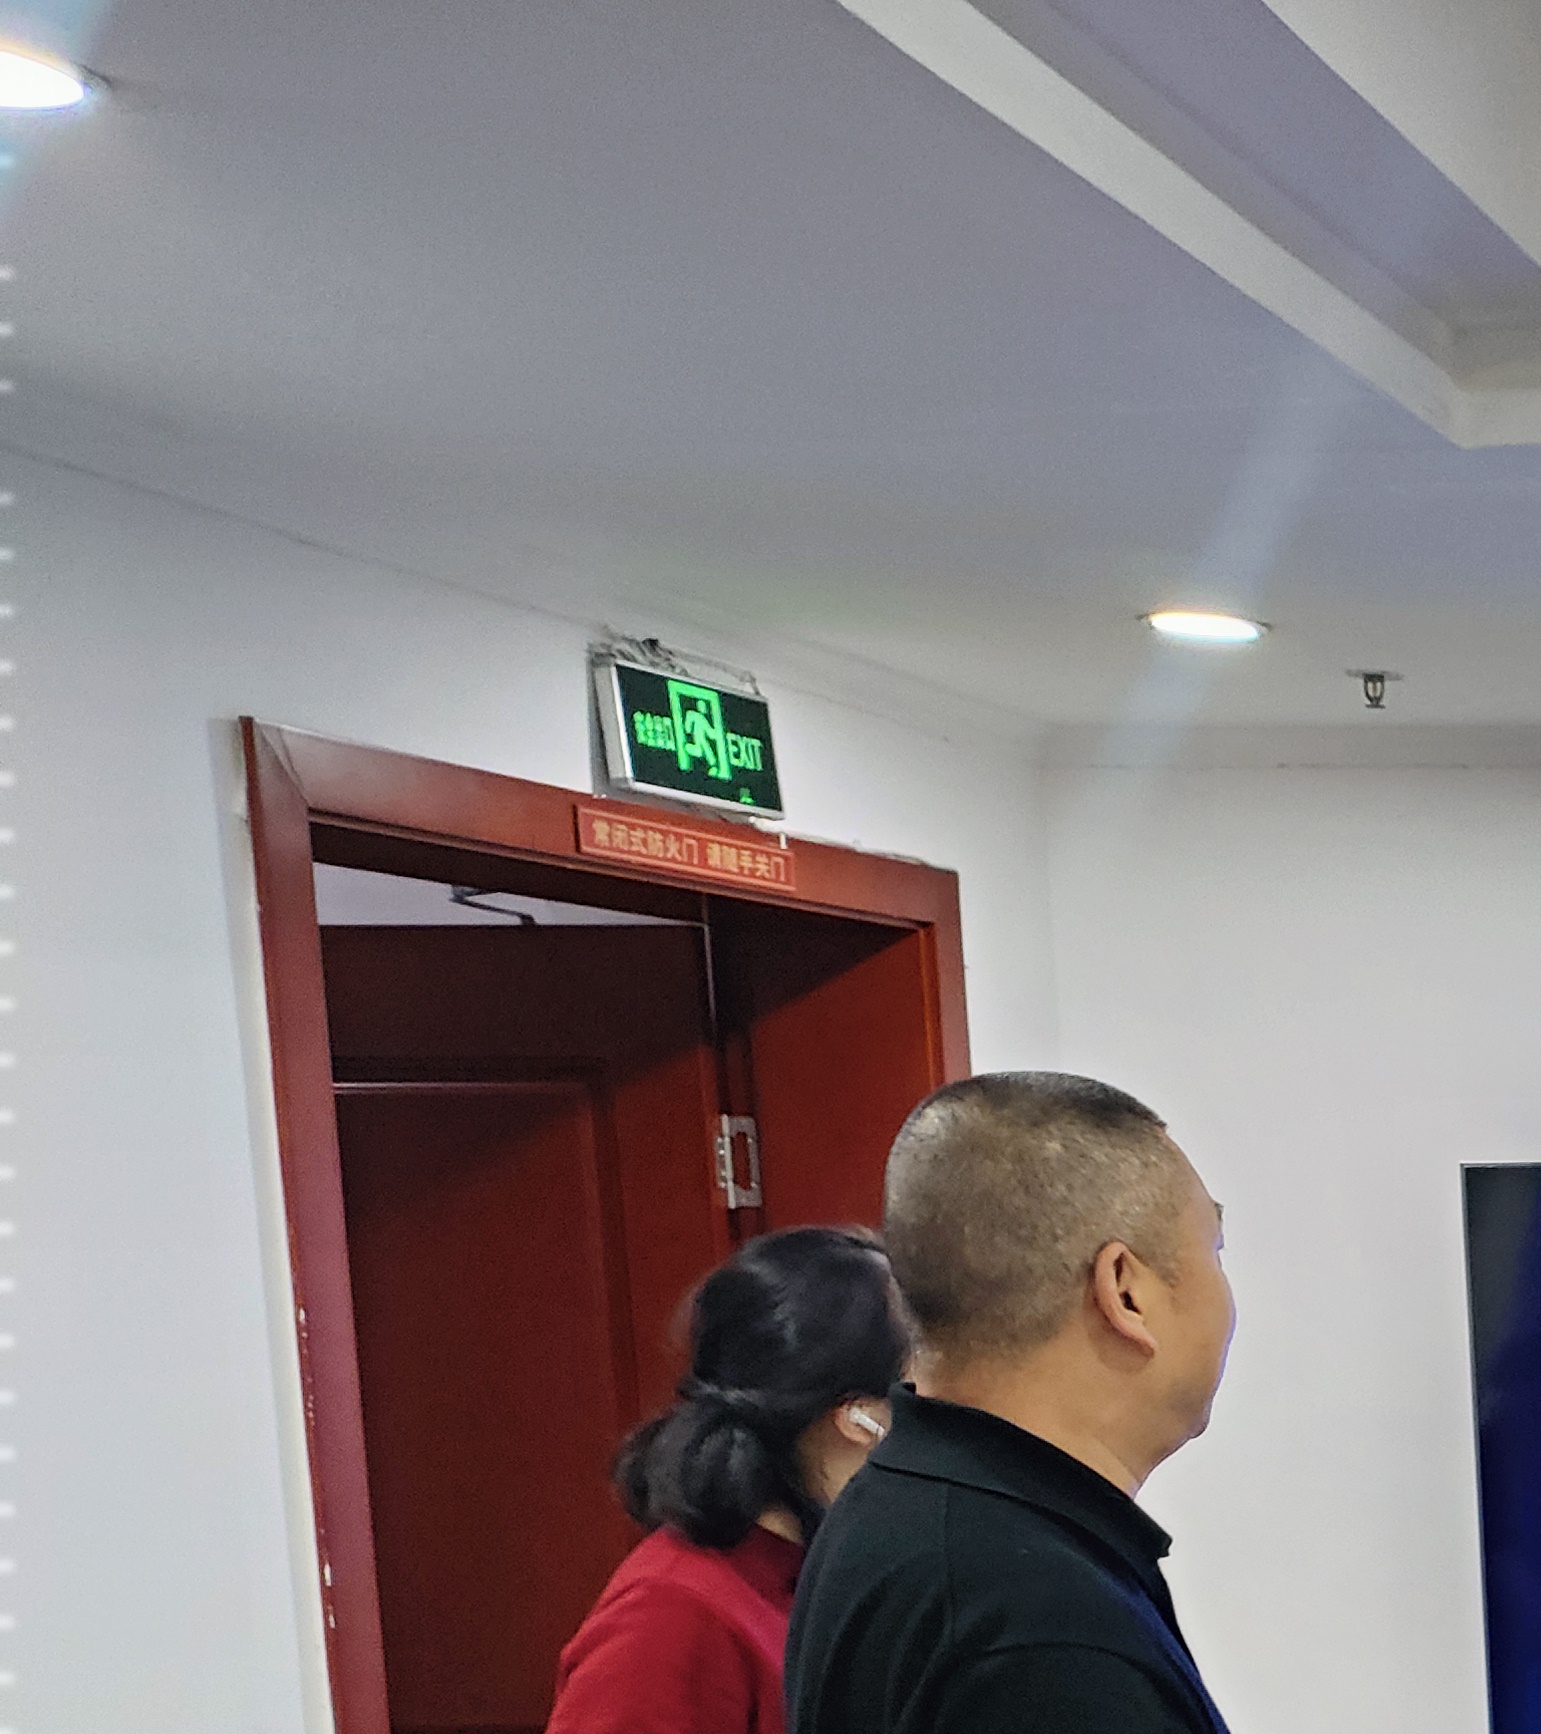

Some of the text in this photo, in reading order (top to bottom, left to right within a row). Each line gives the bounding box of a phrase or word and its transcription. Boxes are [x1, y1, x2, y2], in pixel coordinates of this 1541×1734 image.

[726, 732, 763, 771] EXIT
[593, 820, 786, 881] 常闭式防火门 请随手关门
